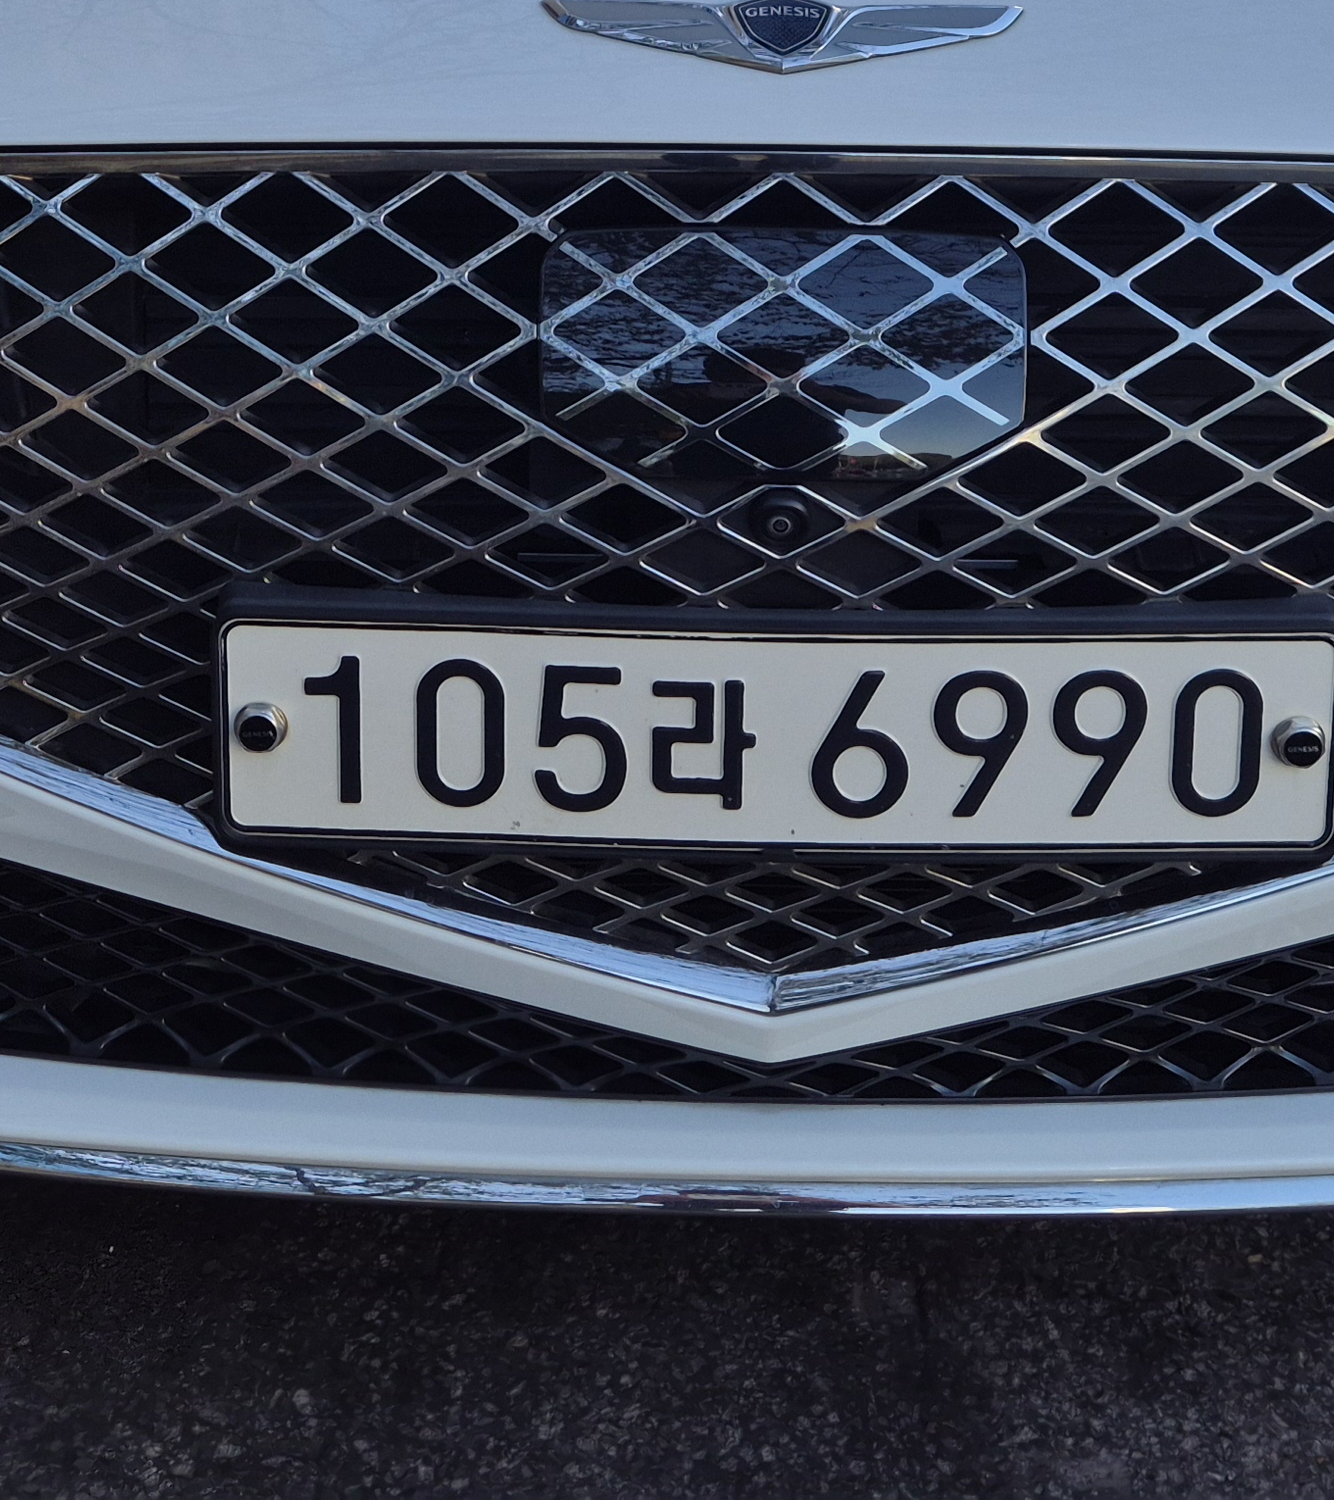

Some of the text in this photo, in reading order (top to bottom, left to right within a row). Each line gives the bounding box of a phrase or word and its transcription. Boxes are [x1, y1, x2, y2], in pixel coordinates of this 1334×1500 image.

[745, 5, 821, 19] GENESIS
[304, 655, 1264, 819] 105라 6990
